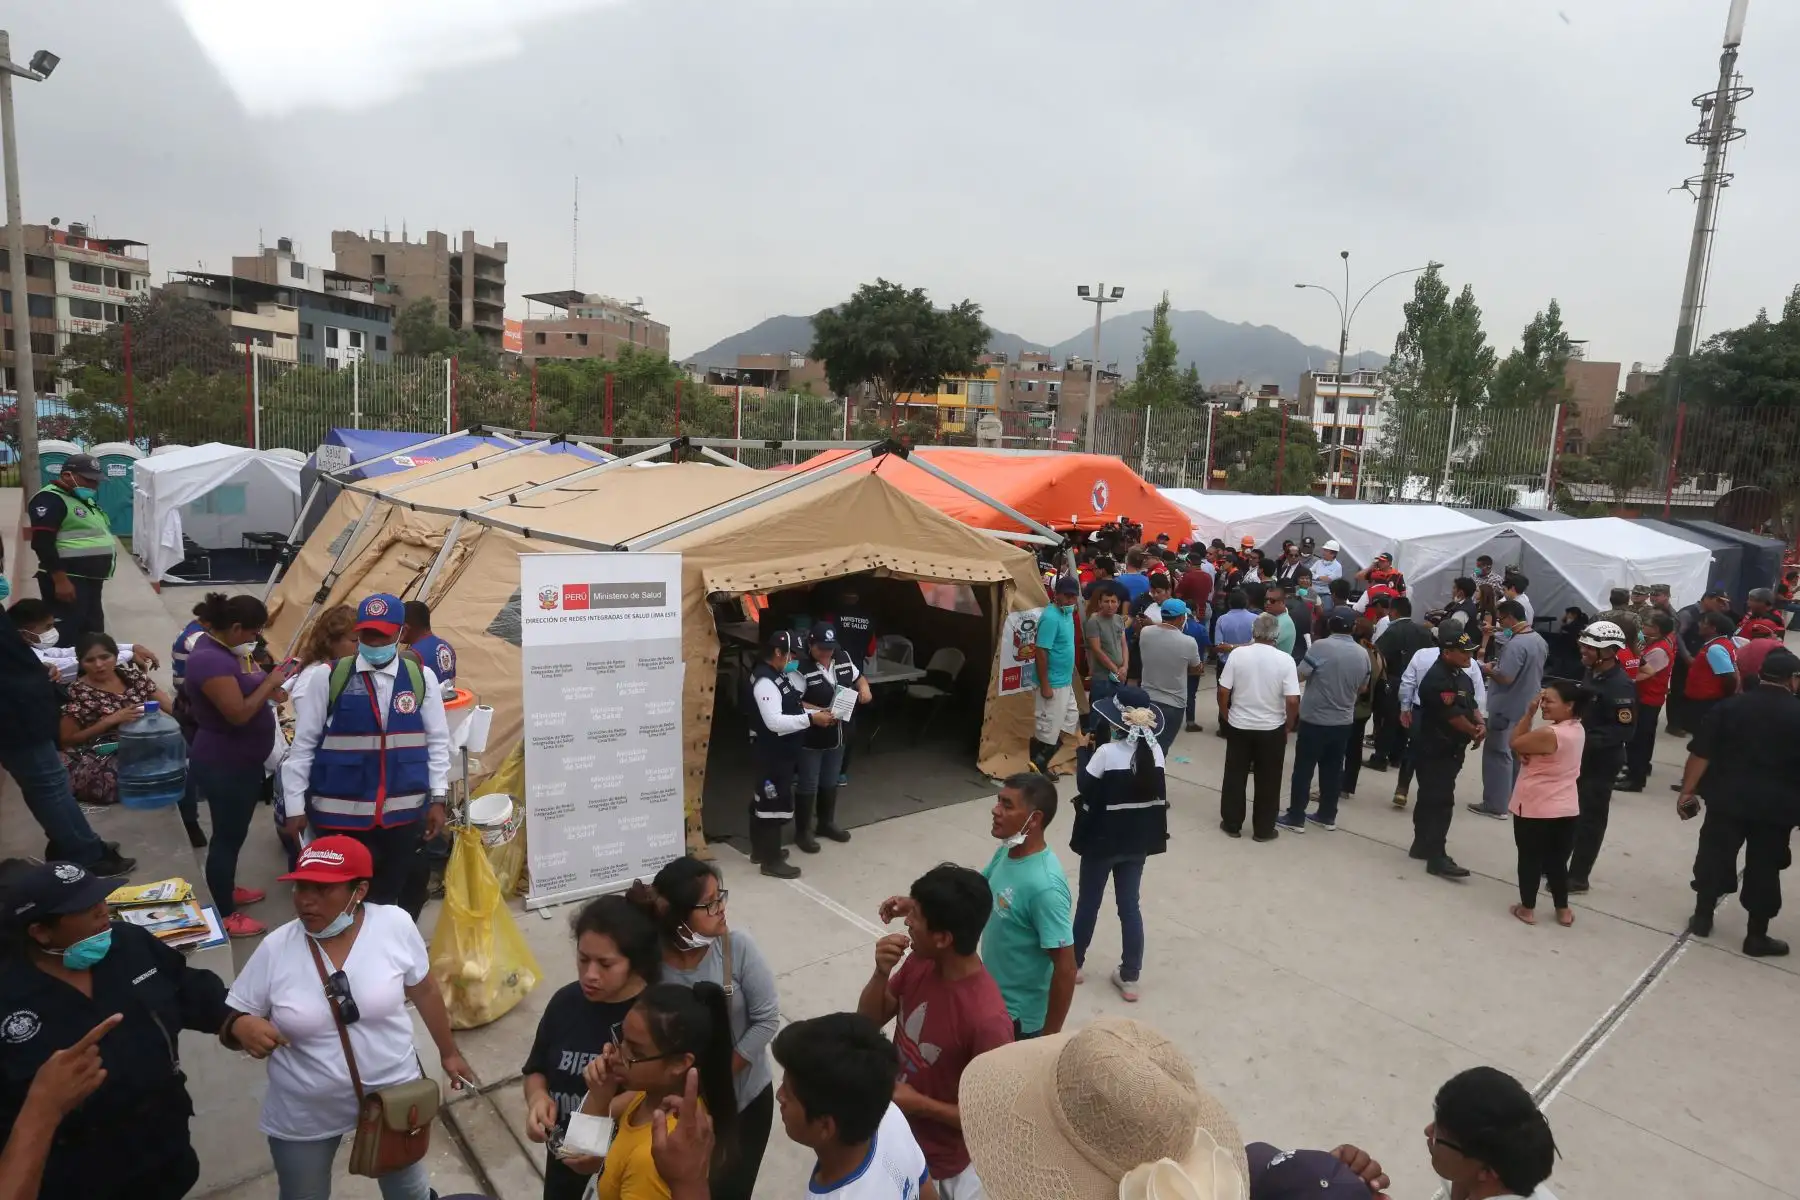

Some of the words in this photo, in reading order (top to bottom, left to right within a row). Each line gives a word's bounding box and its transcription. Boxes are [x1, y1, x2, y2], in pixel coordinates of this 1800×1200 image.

[564, 591, 588, 601] PERÚ
[593, 592, 629, 601] Ministerio
[630, 592, 640, 600] de
[641, 591, 662, 600] Salud
